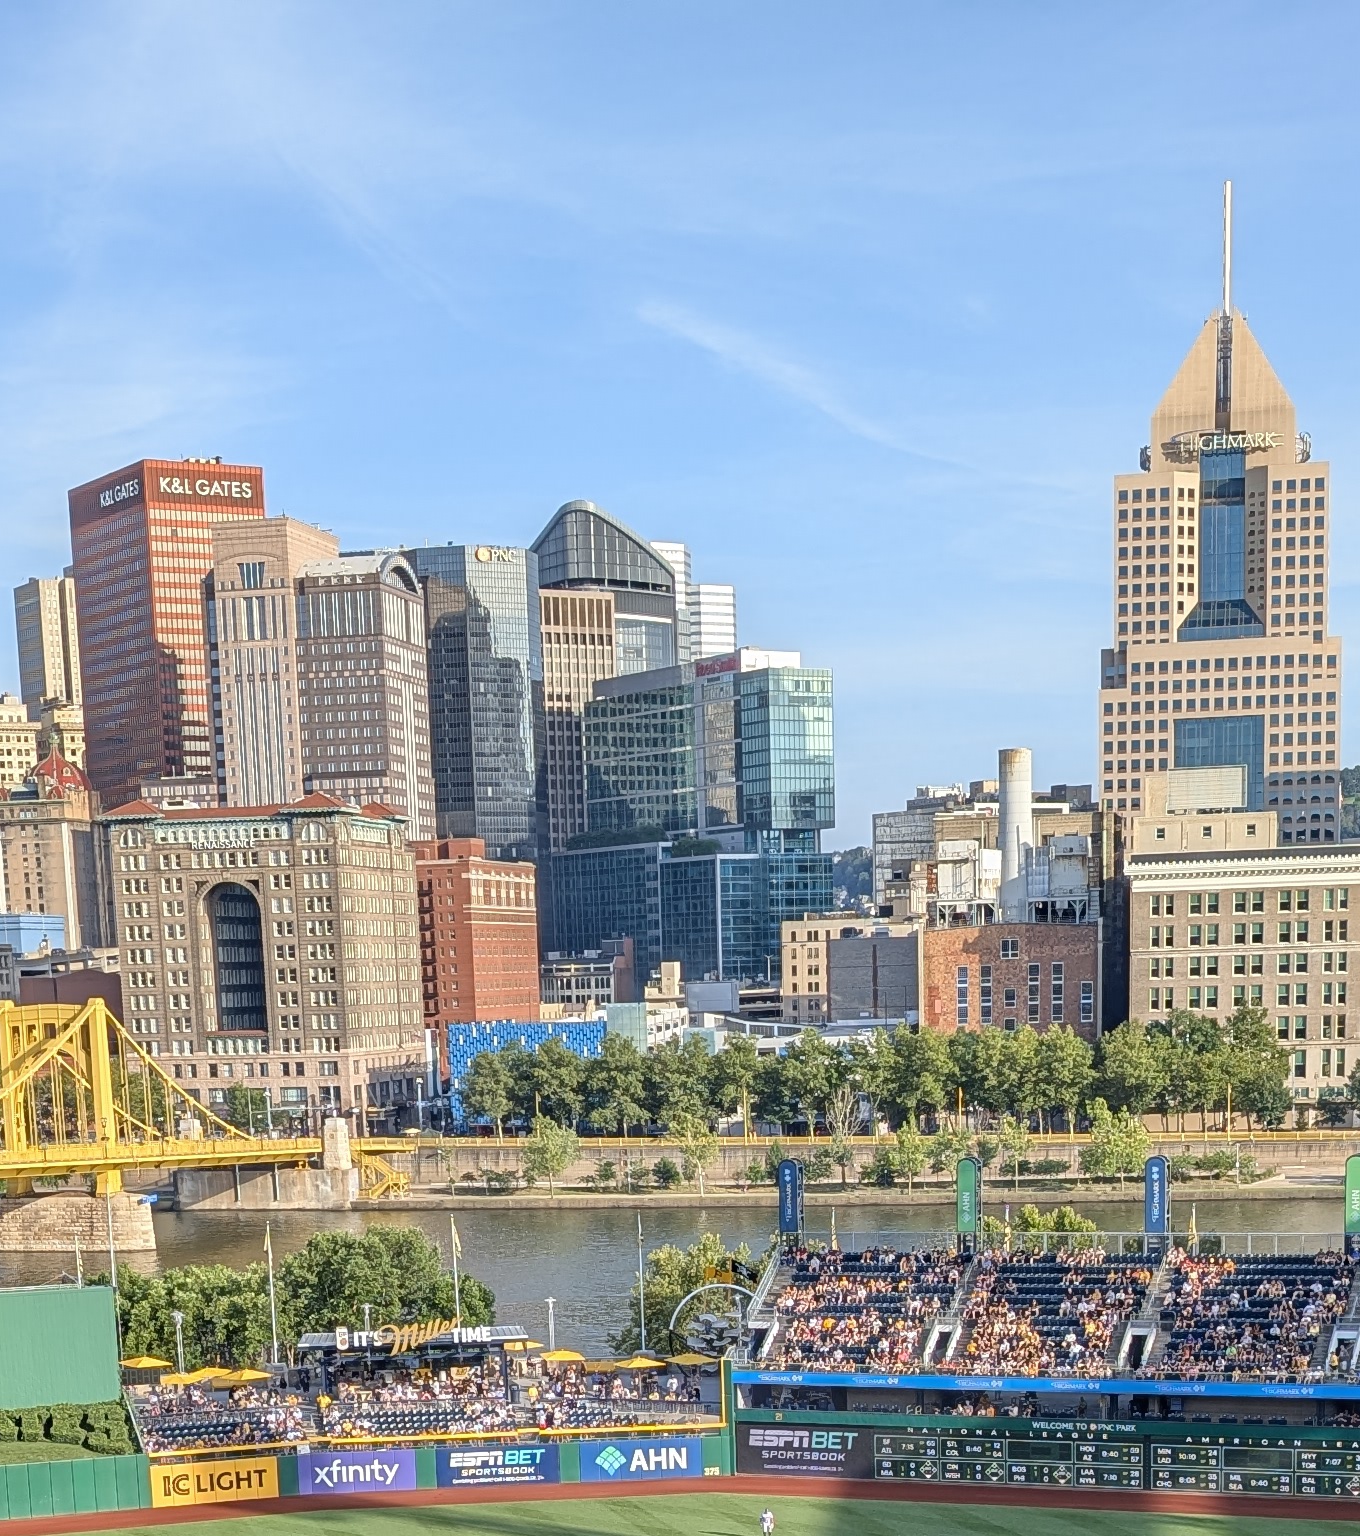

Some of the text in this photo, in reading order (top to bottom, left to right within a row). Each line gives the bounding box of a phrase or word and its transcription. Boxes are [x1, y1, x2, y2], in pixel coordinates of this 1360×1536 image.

[99, 478, 140, 508] K&L GATES
[159, 476, 252, 499] K&L GATES
[490, 548, 517, 562] PNC
[191, 839, 256, 850] RENAISSANCE
[962, 1192, 970, 1212] AHN
[1352, 1190, 1360, 1210] AHN
[353, 1316, 491, 1357] IT'S Miller TIME
[907, 1427, 1108, 1440] NATIONAL LEAGUE
[1032, 1421, 1074, 1430] WELCOME
[1116, 1424, 1136, 1432] PARK
[749, 1429, 858, 1450] ESPN BET
[1186, 1436, 1301, 1446] AMERICAN
[450, 1449, 546, 1468] ESPN BET
[629, 1447, 688, 1472] AHN
[762, 1450, 846, 1461] SPORTSBOOK
[196, 1469, 267, 1492] LIGHT
[314, 1458, 399, 1487] xfinity
[461, 1467, 535, 1476] SPORTSBOOK
[704, 1467, 720, 1476] 375
